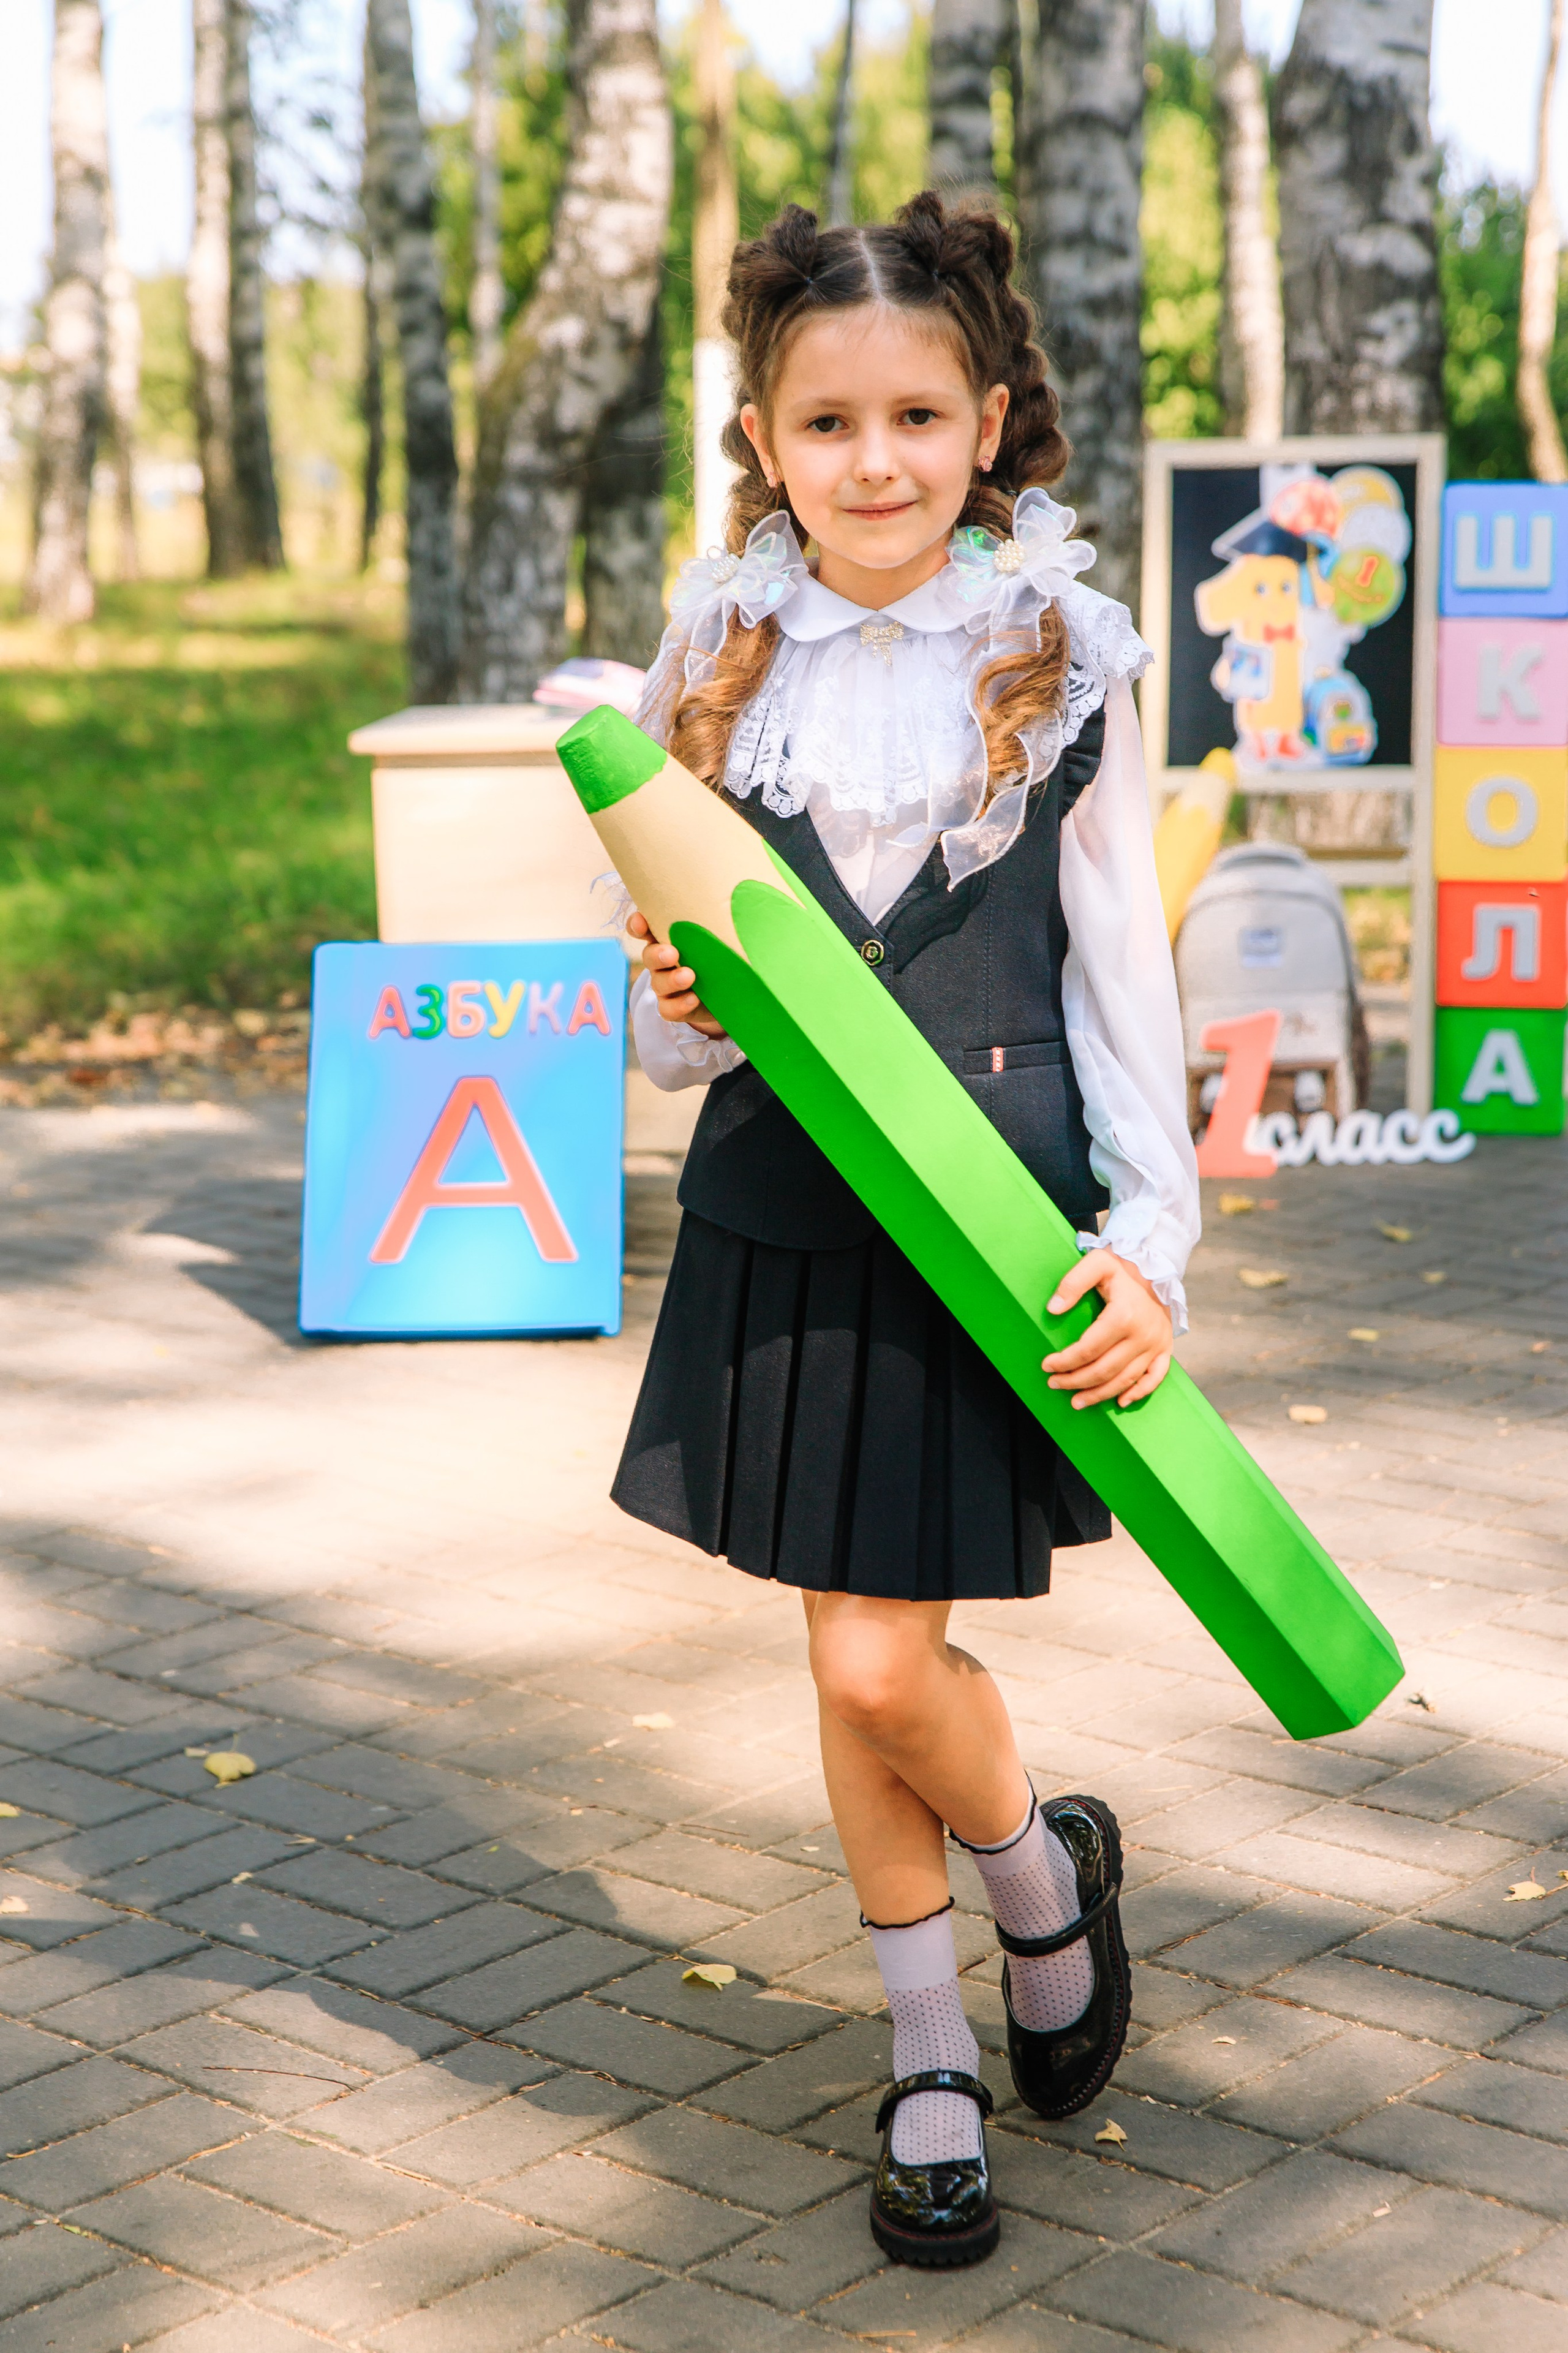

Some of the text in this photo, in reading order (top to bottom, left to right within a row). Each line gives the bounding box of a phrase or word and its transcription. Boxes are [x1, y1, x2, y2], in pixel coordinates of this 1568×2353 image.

[369, 981, 611, 1039] АЗБУКА
[1197, 1007, 1281, 1178] 1
[371, 1075, 578, 1263] А
